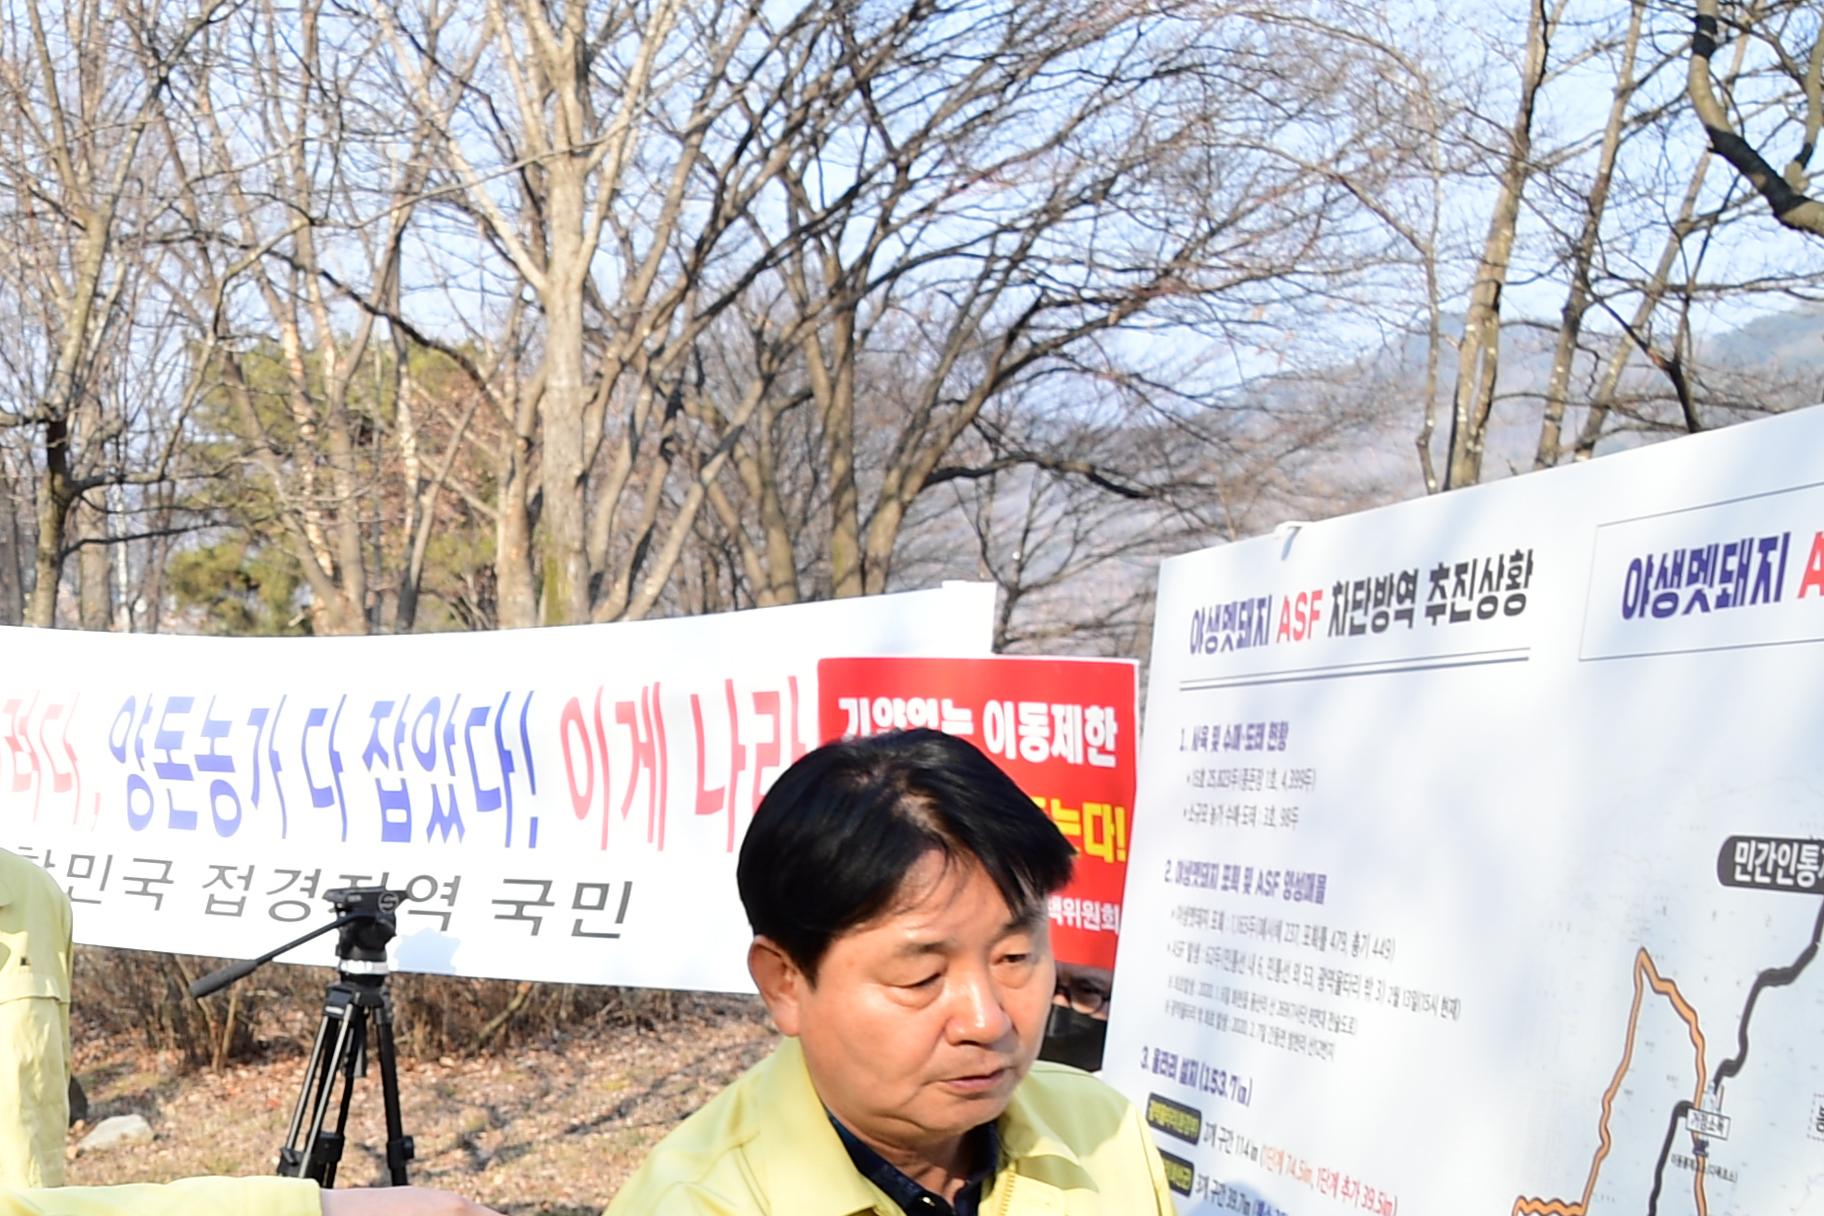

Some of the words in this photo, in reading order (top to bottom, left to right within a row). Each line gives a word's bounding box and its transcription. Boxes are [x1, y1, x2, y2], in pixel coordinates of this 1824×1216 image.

[1189, 595, 1273, 655] 야생멧돼지
[1276, 589, 1324, 644] ASF
[1327, 567, 1420, 638] 차단방역
[1424, 548, 1535, 626] 추진상황
[1622, 531, 1793, 620] 야생멧돼지
[108, 692, 288, 838] 양돈농가
[300, 693, 349, 843] 다
[362, 689, 538, 849] 잡았다!
[559, 682, 669, 852] 이게
[982, 699, 1119, 768] 이동제한
[1032, 797, 1127, 864] 는다!
[491, 877, 635, 940] 국민
[1255, 868, 1280, 898] ASF
